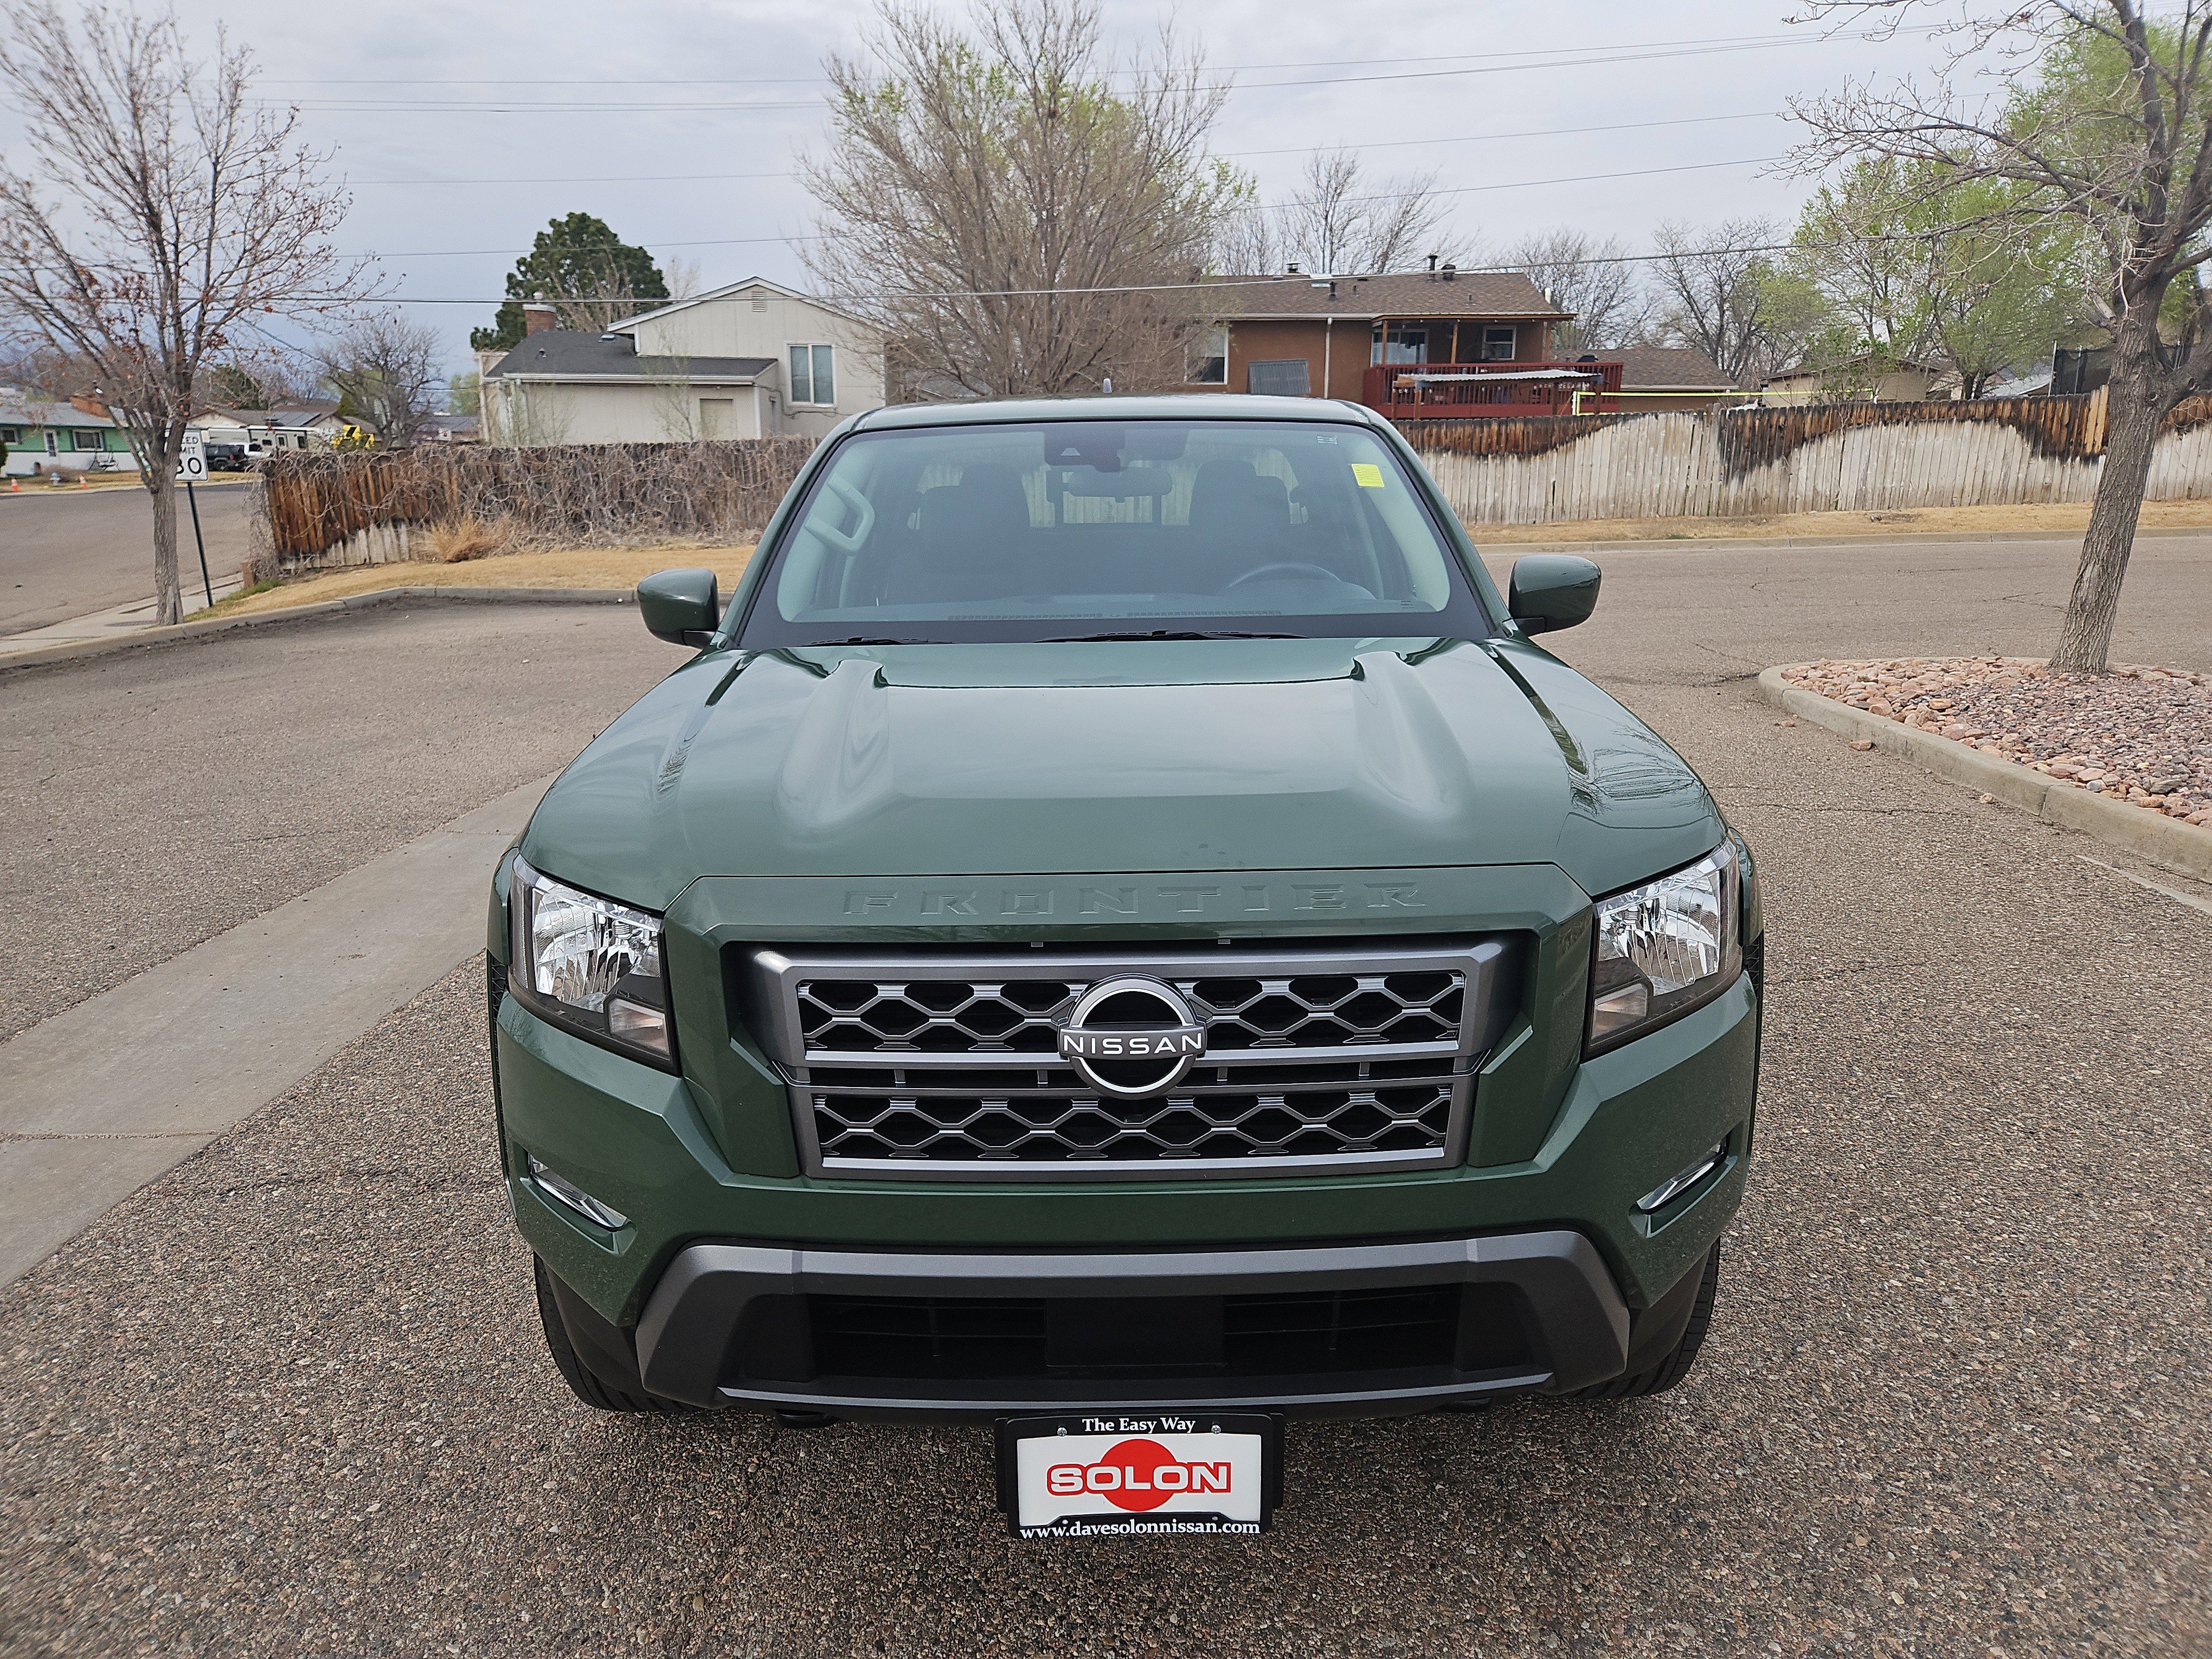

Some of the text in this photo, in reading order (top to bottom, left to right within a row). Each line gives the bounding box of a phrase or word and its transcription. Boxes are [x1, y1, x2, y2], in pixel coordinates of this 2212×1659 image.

[843, 882, 1426, 915] FRONTIER
[1063, 1033, 1202, 1055] NISSAN
[1082, 1417, 1196, 1434] The Easy Way
[1047, 1462, 1231, 1496] SOLON
[1019, 1519, 1261, 1539] www.davesolonnissan.com
